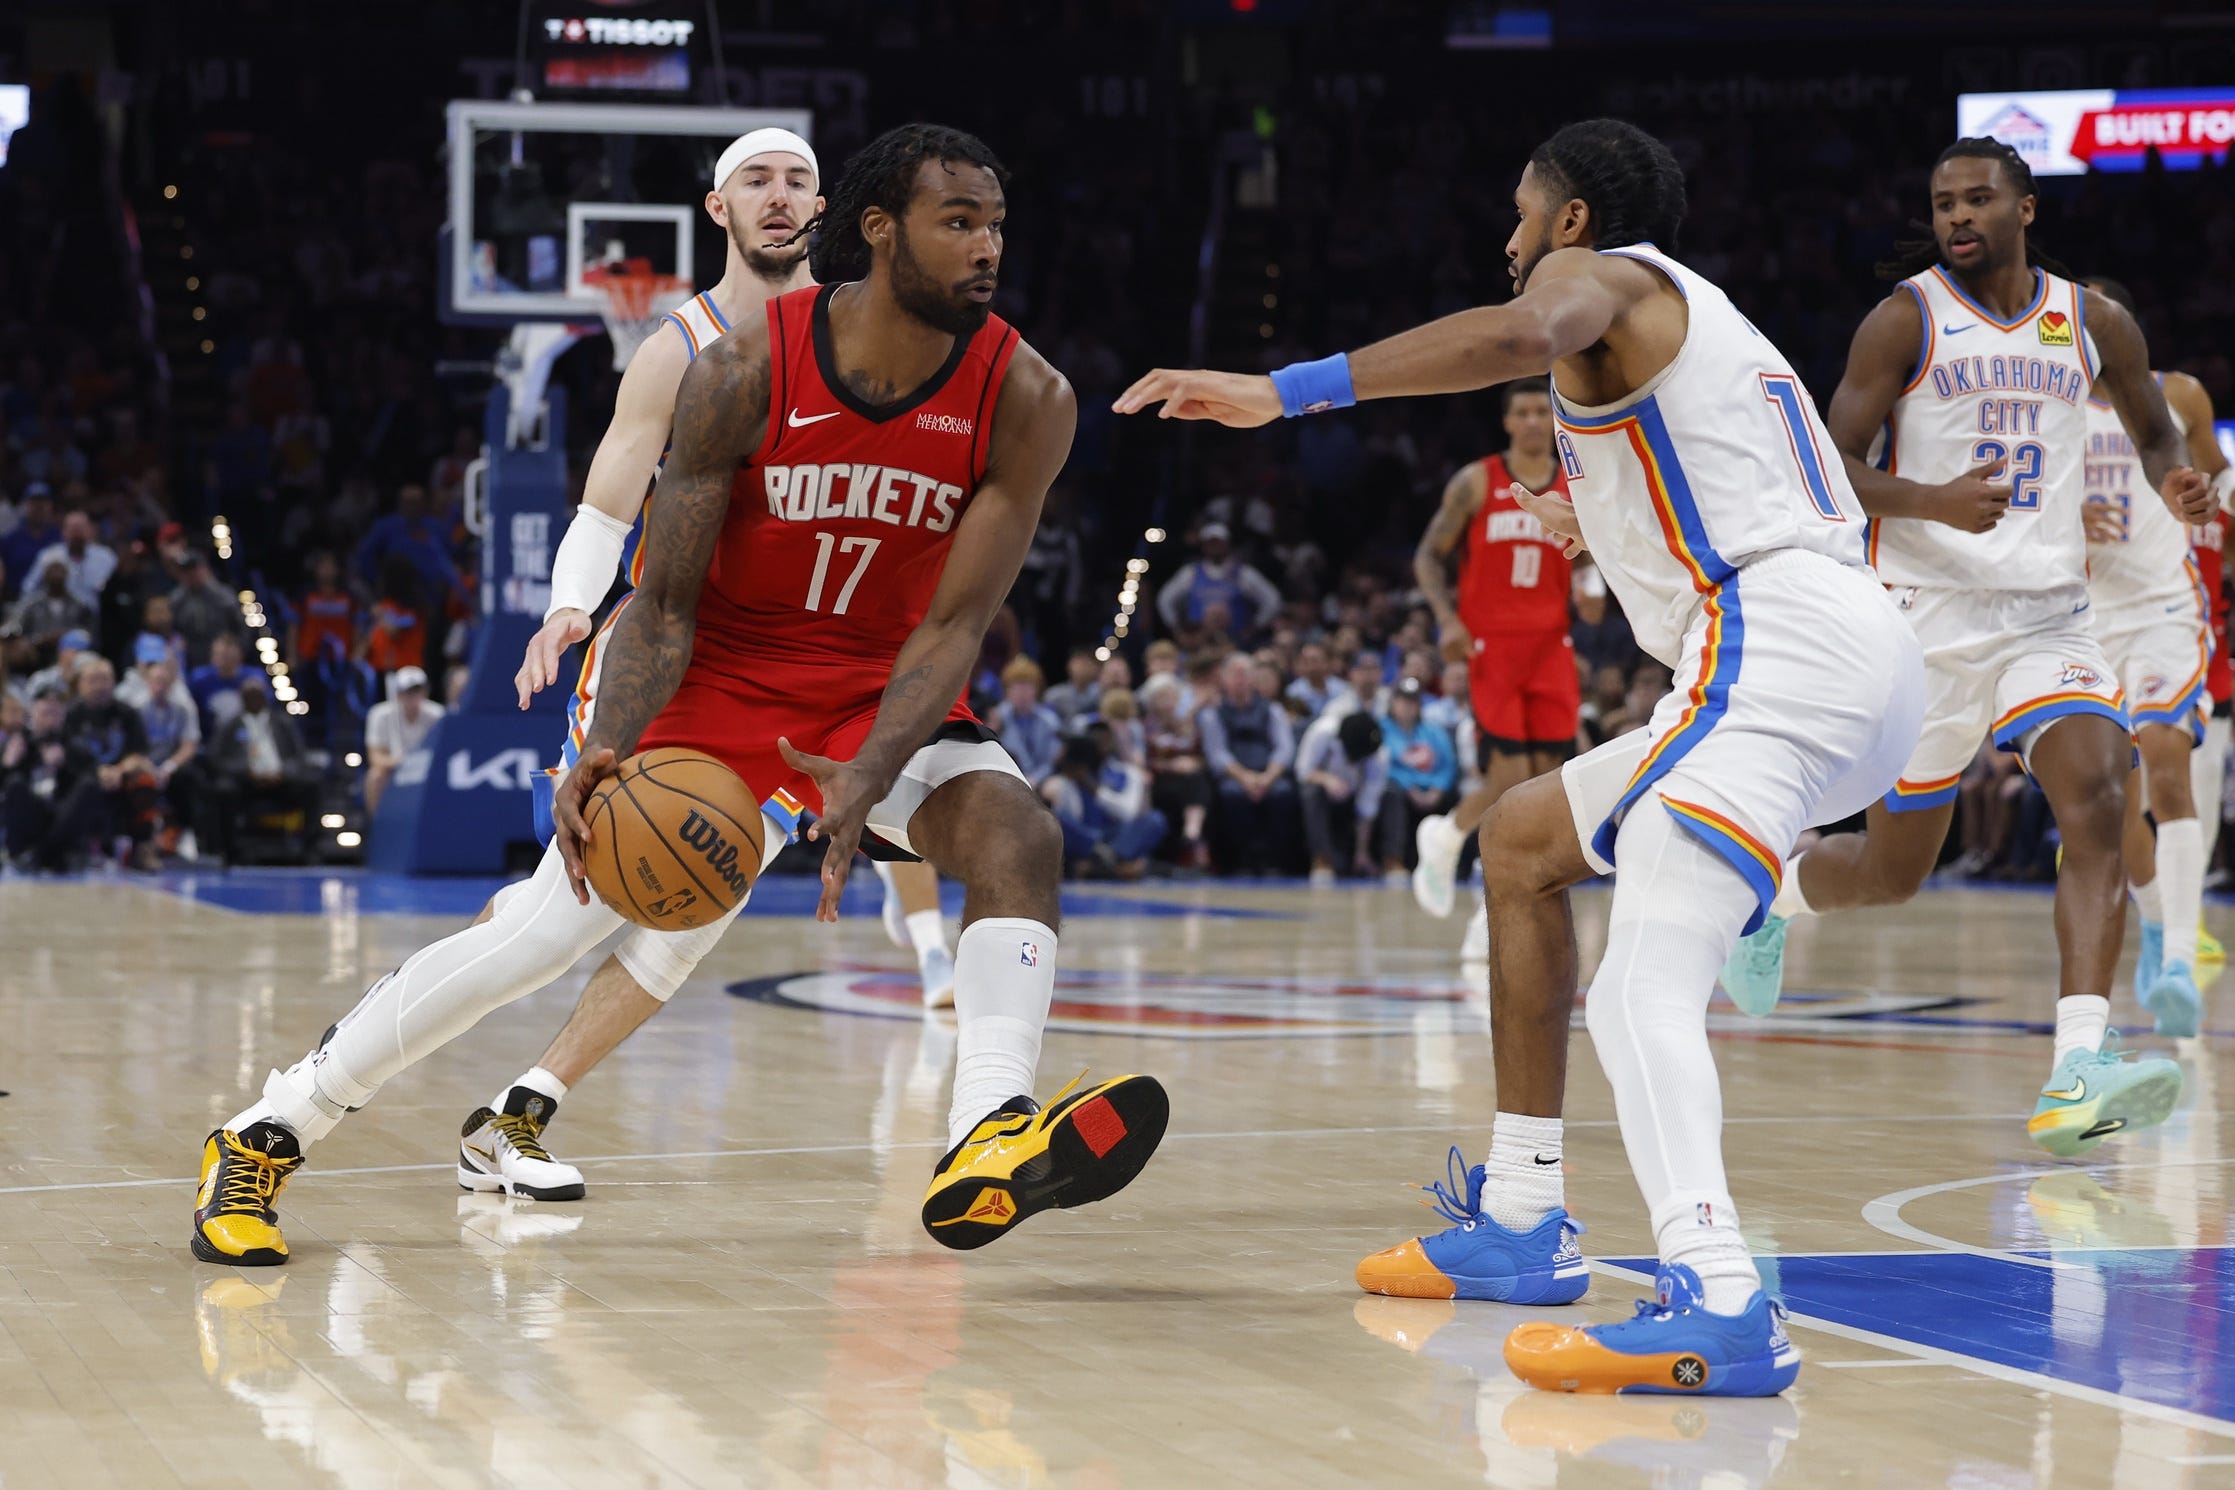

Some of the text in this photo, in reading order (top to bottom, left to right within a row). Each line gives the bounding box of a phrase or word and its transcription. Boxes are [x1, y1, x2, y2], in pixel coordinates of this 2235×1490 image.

[586, 19, 695, 46] TISSOT
[2095, 109, 2235, 146] BUILT FO
[1931, 355, 2085, 405] OKLAHOMA
[916, 420, 972, 435] HERMANN
[917, 412, 971, 429] MEMORIAL
[1979, 400, 2042, 435] CITY
[764, 462, 964, 533] ROCKETS
[805, 531, 882, 615] 17
[1511, 544, 1541, 588] 10
[680, 809, 748, 899] Wilson
